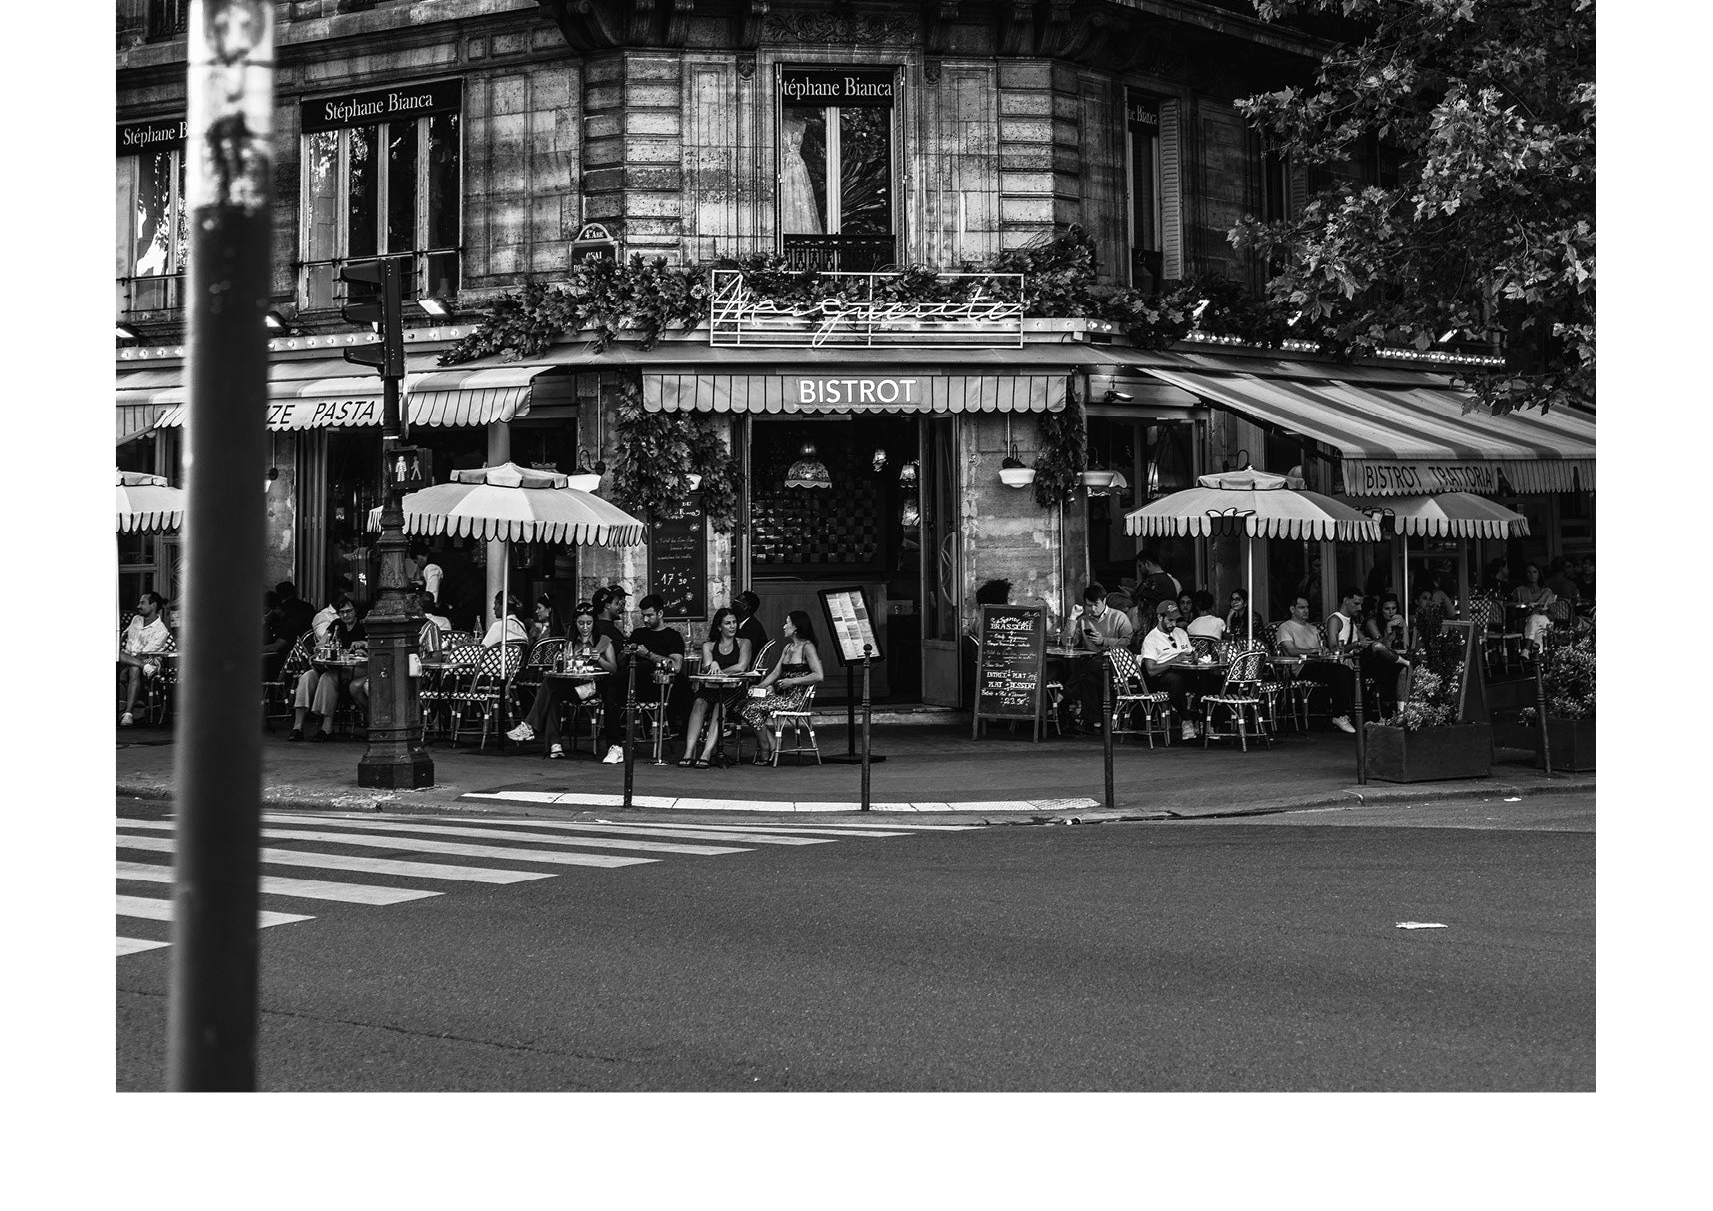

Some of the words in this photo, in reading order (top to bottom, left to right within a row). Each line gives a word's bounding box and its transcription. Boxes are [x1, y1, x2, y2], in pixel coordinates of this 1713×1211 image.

[782, 76, 841, 101] téphane
[844, 76, 893, 97] Bianca
[324, 99, 385, 123] Stéphane
[388, 91, 434, 112] Bianca
[122, 125, 174, 147] Stéphane
[799, 378, 918, 404] BISTROT
[266, 403, 297, 425] ZE
[312, 400, 376, 424] PASTA
[1365, 465, 1423, 489] BISTROT
[1428, 465, 1493, 490] TRATTORIA
